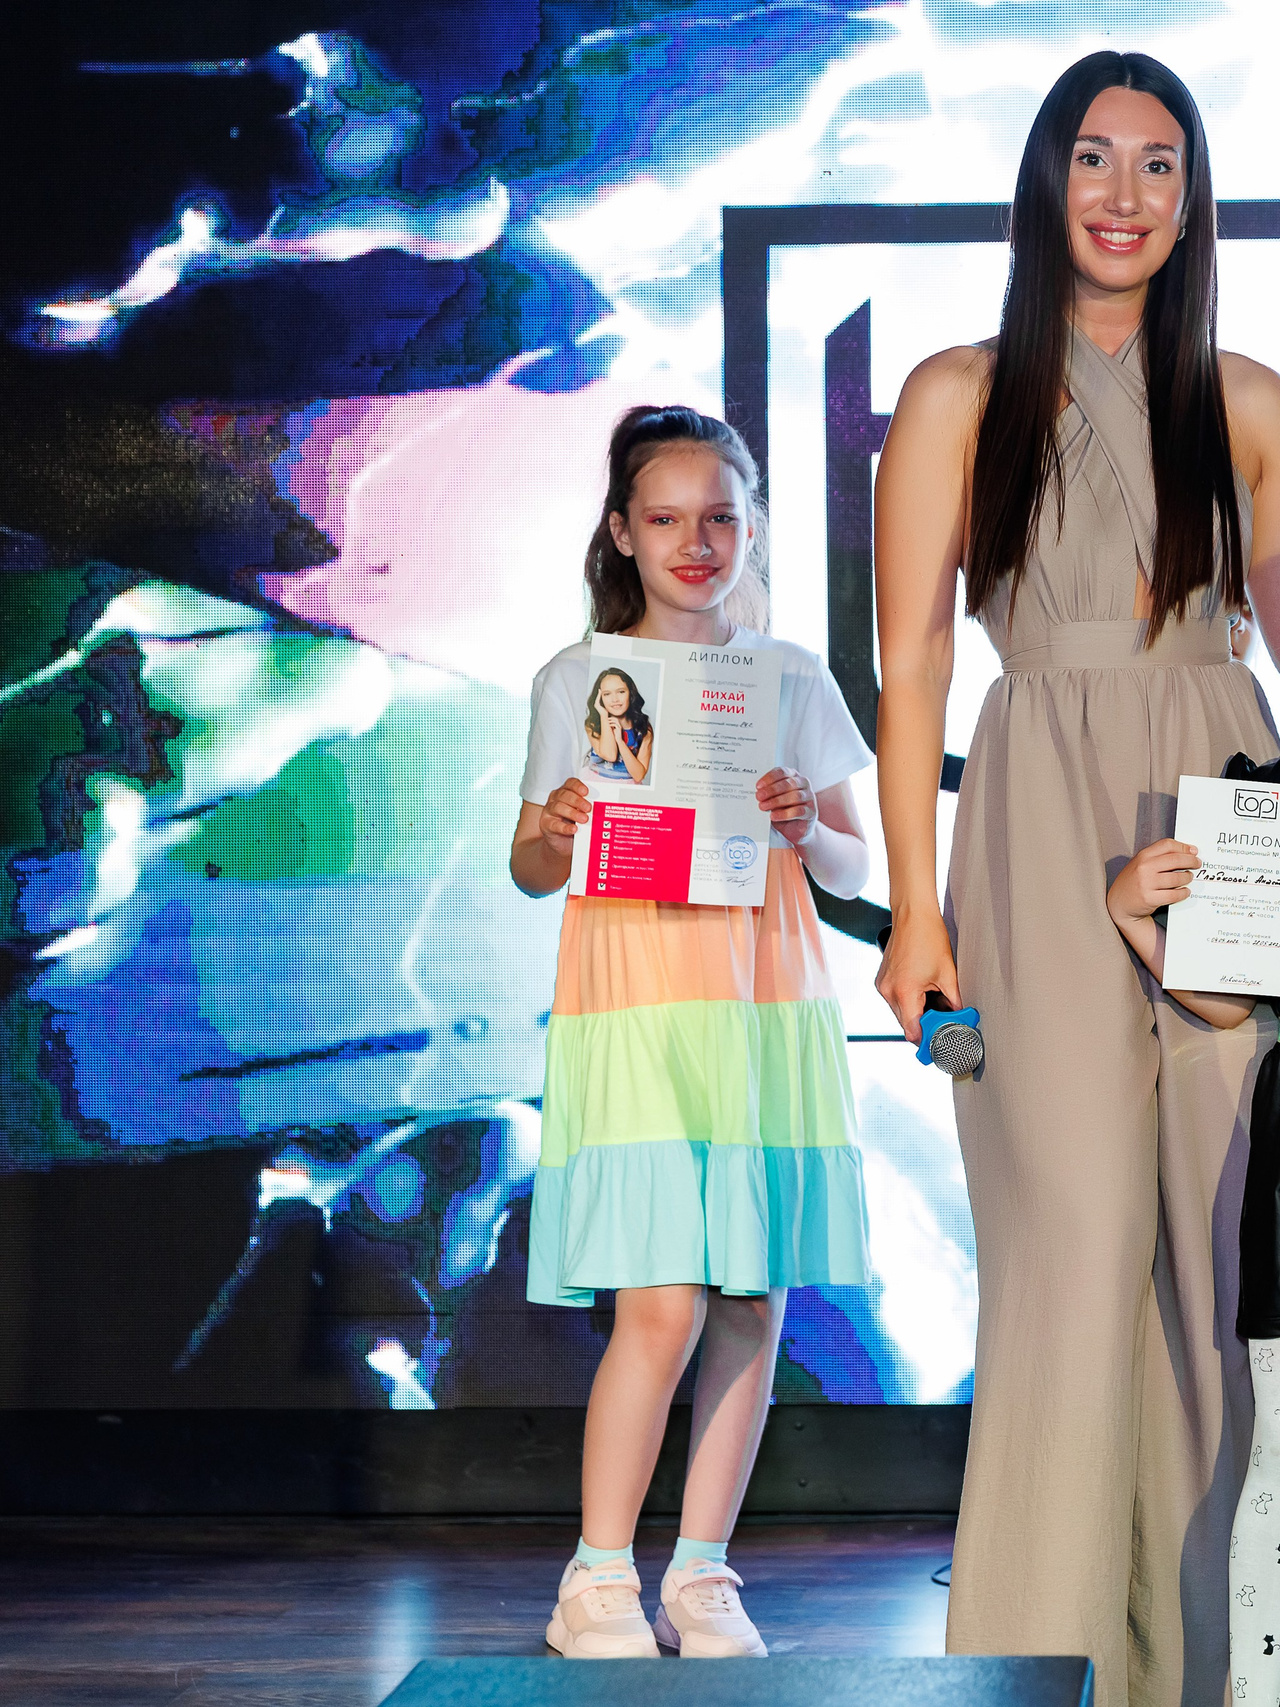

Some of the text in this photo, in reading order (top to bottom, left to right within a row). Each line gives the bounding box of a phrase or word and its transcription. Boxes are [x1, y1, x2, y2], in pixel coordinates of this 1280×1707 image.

[689, 652, 753, 665] ДИПЛОМ
[702, 690, 745, 702] ПИХАЙ
[700, 702, 744, 714] МАРИИ
[1237, 792, 1274, 818] top
[1217, 847, 1270, 857] Регистрационный
[1202, 862, 1244, 871] Настоящий
[1246, 866, 1273, 875] диплом
[1190, 893, 1237, 902] рошедшему(ей)
[1218, 930, 1241, 938] Период
